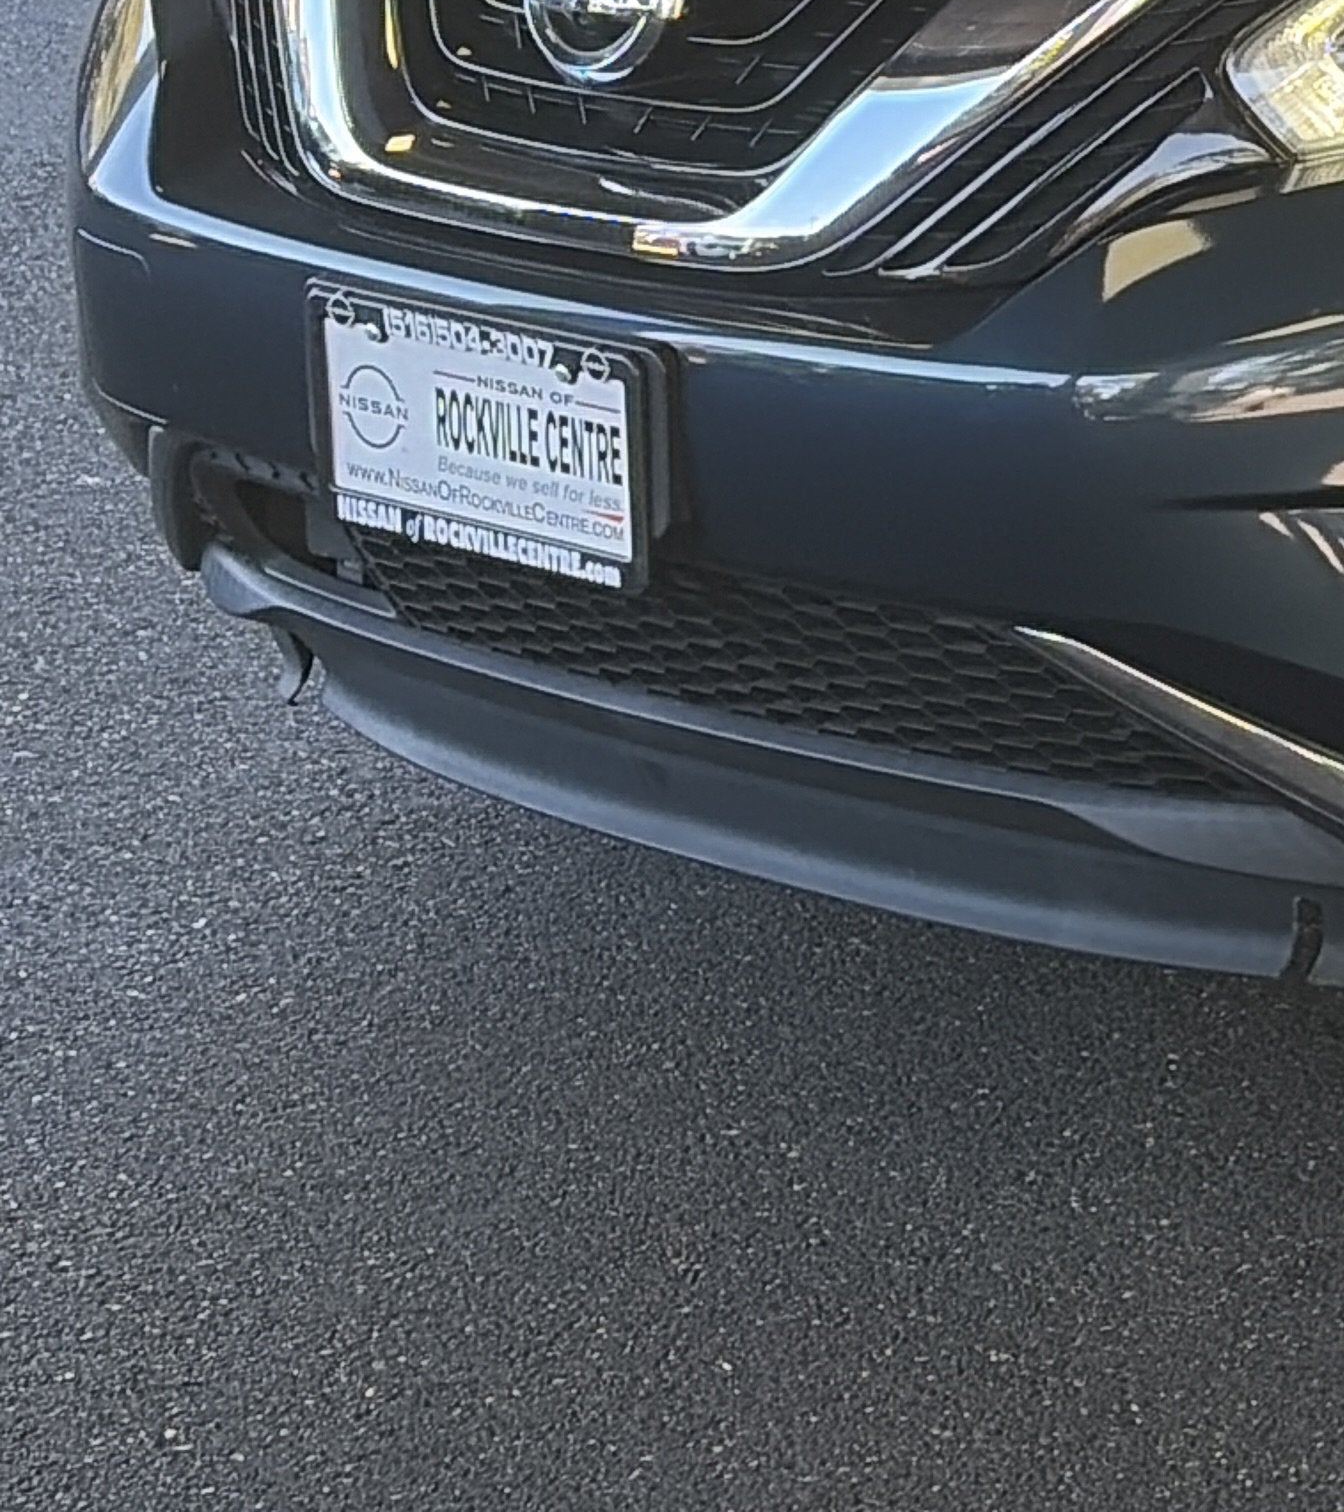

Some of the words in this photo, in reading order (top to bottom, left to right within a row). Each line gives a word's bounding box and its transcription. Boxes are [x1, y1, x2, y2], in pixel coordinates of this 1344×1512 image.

[338, 392, 409, 421] NISSAN
[476, 374, 543, 401] NISSAN
[549, 390, 575, 407] OF
[434, 386, 541, 468] ROCKVILLE
[545, 409, 624, 486] CENTRE
[437, 454, 502, 486] Because
[506, 473, 529, 489] we
[533, 479, 561, 498] sell
[563, 486, 585, 504] for
[336, 494, 402, 534] NISSAN
[406, 513, 423, 544] of
